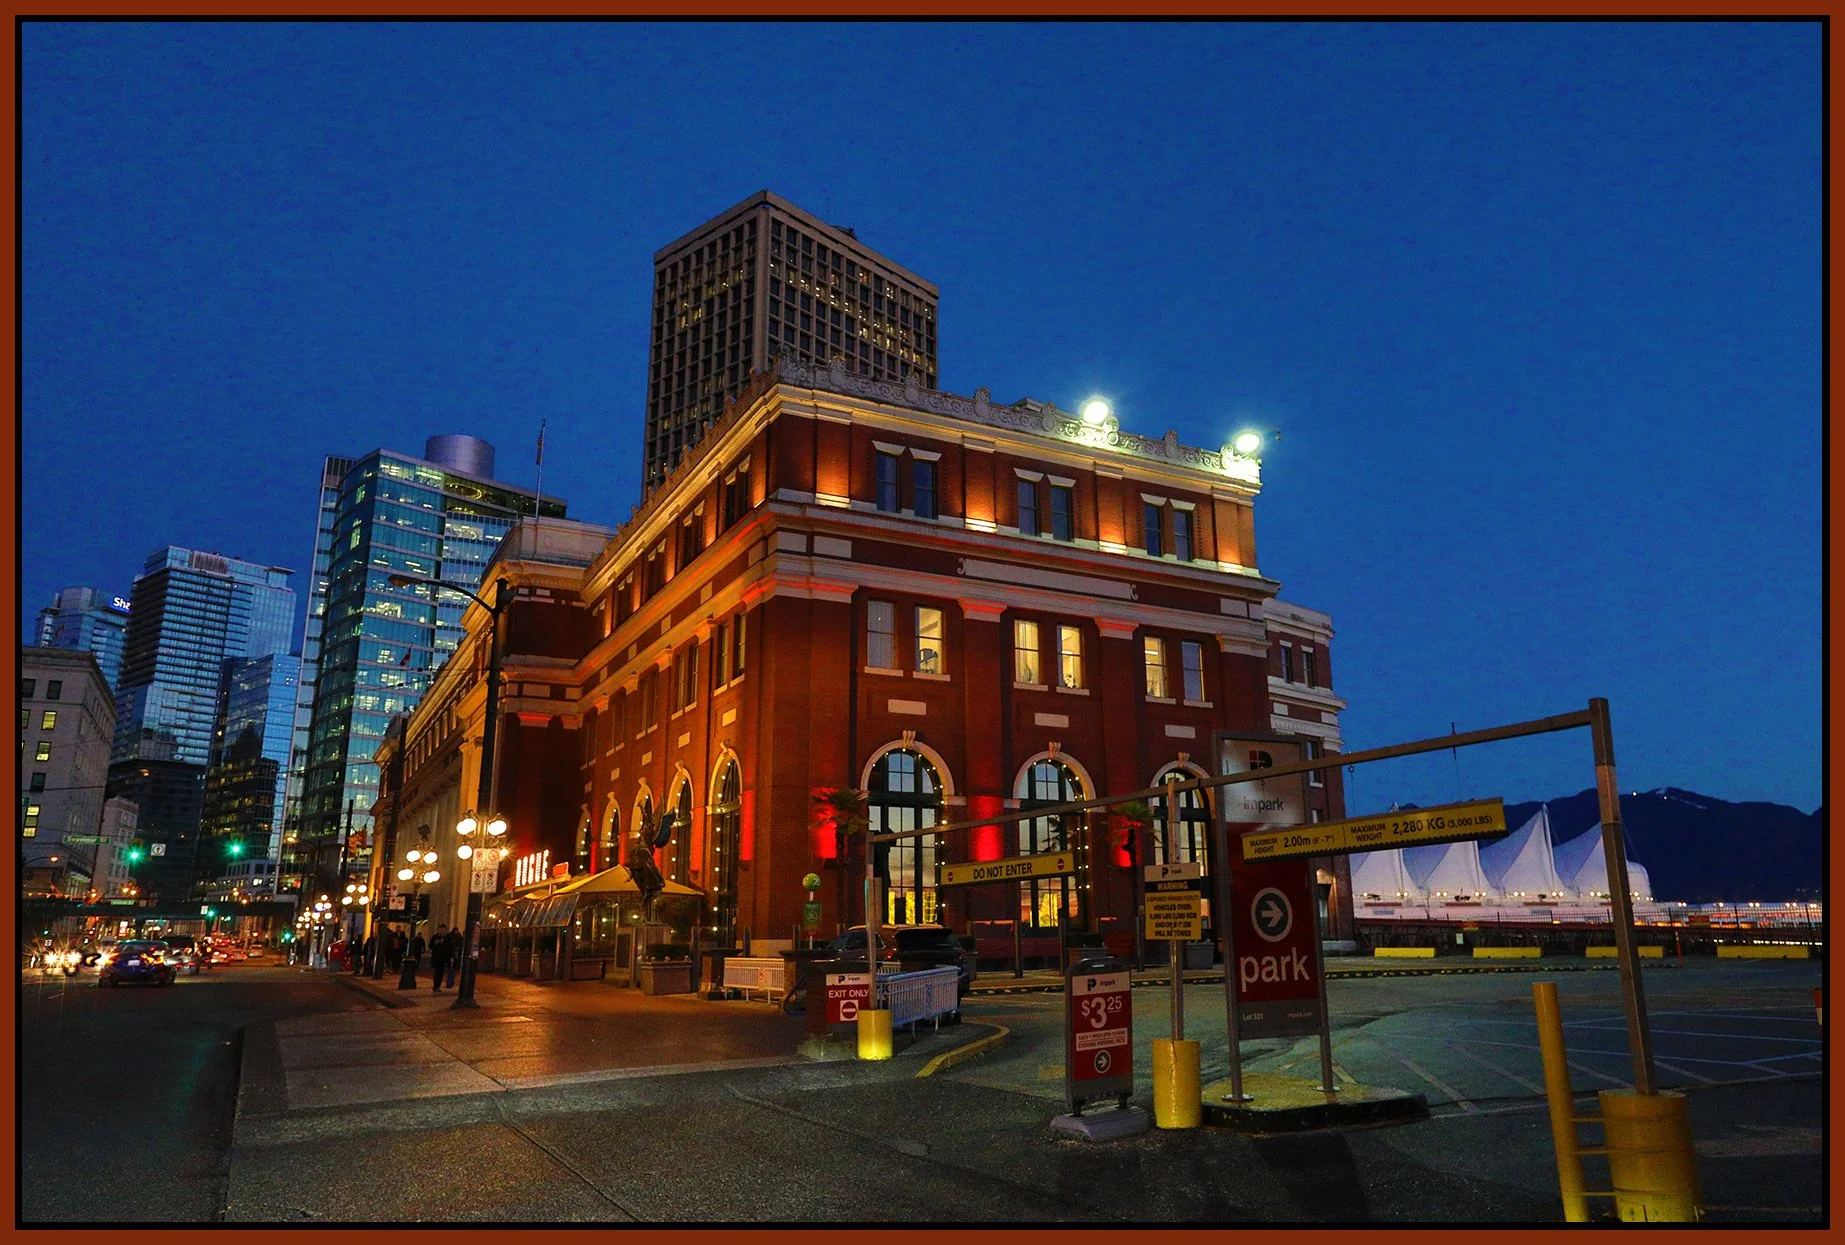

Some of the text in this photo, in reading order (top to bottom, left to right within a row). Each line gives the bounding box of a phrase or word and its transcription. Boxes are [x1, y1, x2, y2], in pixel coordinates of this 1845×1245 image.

[1243, 797, 1285, 813] impark
[1350, 815, 1493, 836] MAXIMUM 2,280 KG (5,000 LBS)
[1250, 836, 1278, 847] MAXIMUM
[1283, 835, 1311, 848] 2.00m
[1355, 832, 1384, 843] WEIGHT
[1254, 846, 1275, 854] HEIGHT
[973, 862, 1033, 880] DO NOT ENTER
[1157, 881, 1189, 891] WARNING
[1173, 929, 1192, 937] TOWED
[1239, 946, 1310, 993] park
[828, 989, 847, 999] EXIT
[848, 988, 869, 998] ONLY
